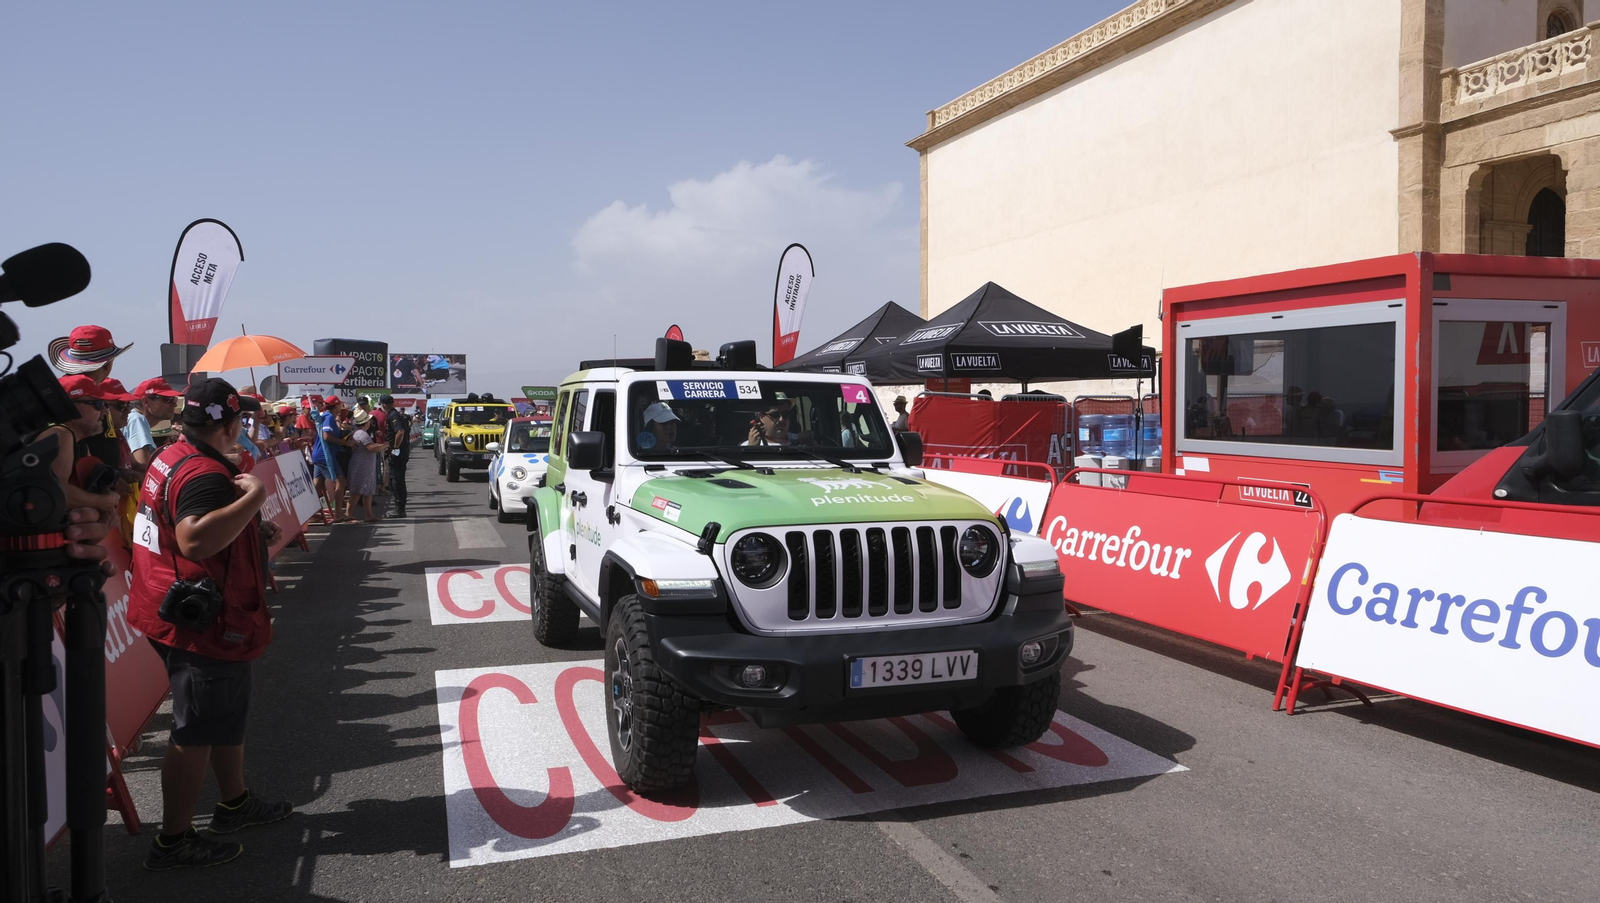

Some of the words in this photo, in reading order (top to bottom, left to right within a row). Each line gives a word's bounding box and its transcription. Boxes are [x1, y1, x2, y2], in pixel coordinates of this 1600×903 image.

[190, 252, 208, 286] ACCESO
[203, 263, 218, 285] META
[784, 275, 795, 305] ACCESO
[789, 274, 802, 311] INVITADOS
[922, 326, 956, 341] VUELTA
[991, 324, 1016, 335] LA
[1012, 324, 1073, 336] VUELTA
[919, 358, 925, 369] LA
[924, 357, 941, 368] VUELTA
[956, 355, 966, 367] LA
[966, 355, 997, 367] VUELTA
[1112, 357, 1122, 368] LA
[284, 365, 326, 374] Carrefour
[343, 377, 385, 387] ertiberia
[683, 381, 724, 390] SERVICIO
[684, 390, 727, 398] CARRERA
[739, 385, 758, 394] 534
[855, 390, 867, 403] 4
[1243, 485, 1254, 497] LA
[1255, 486, 1290, 501] VUELTA
[811, 493, 915, 507] plenitude
[576, 518, 602, 547] plenitude
[1046, 515, 1192, 580] Carrefour
[870, 658, 924, 683] 1339
[931, 654, 971, 680] LVV
[854, 675, 860, 683] E
